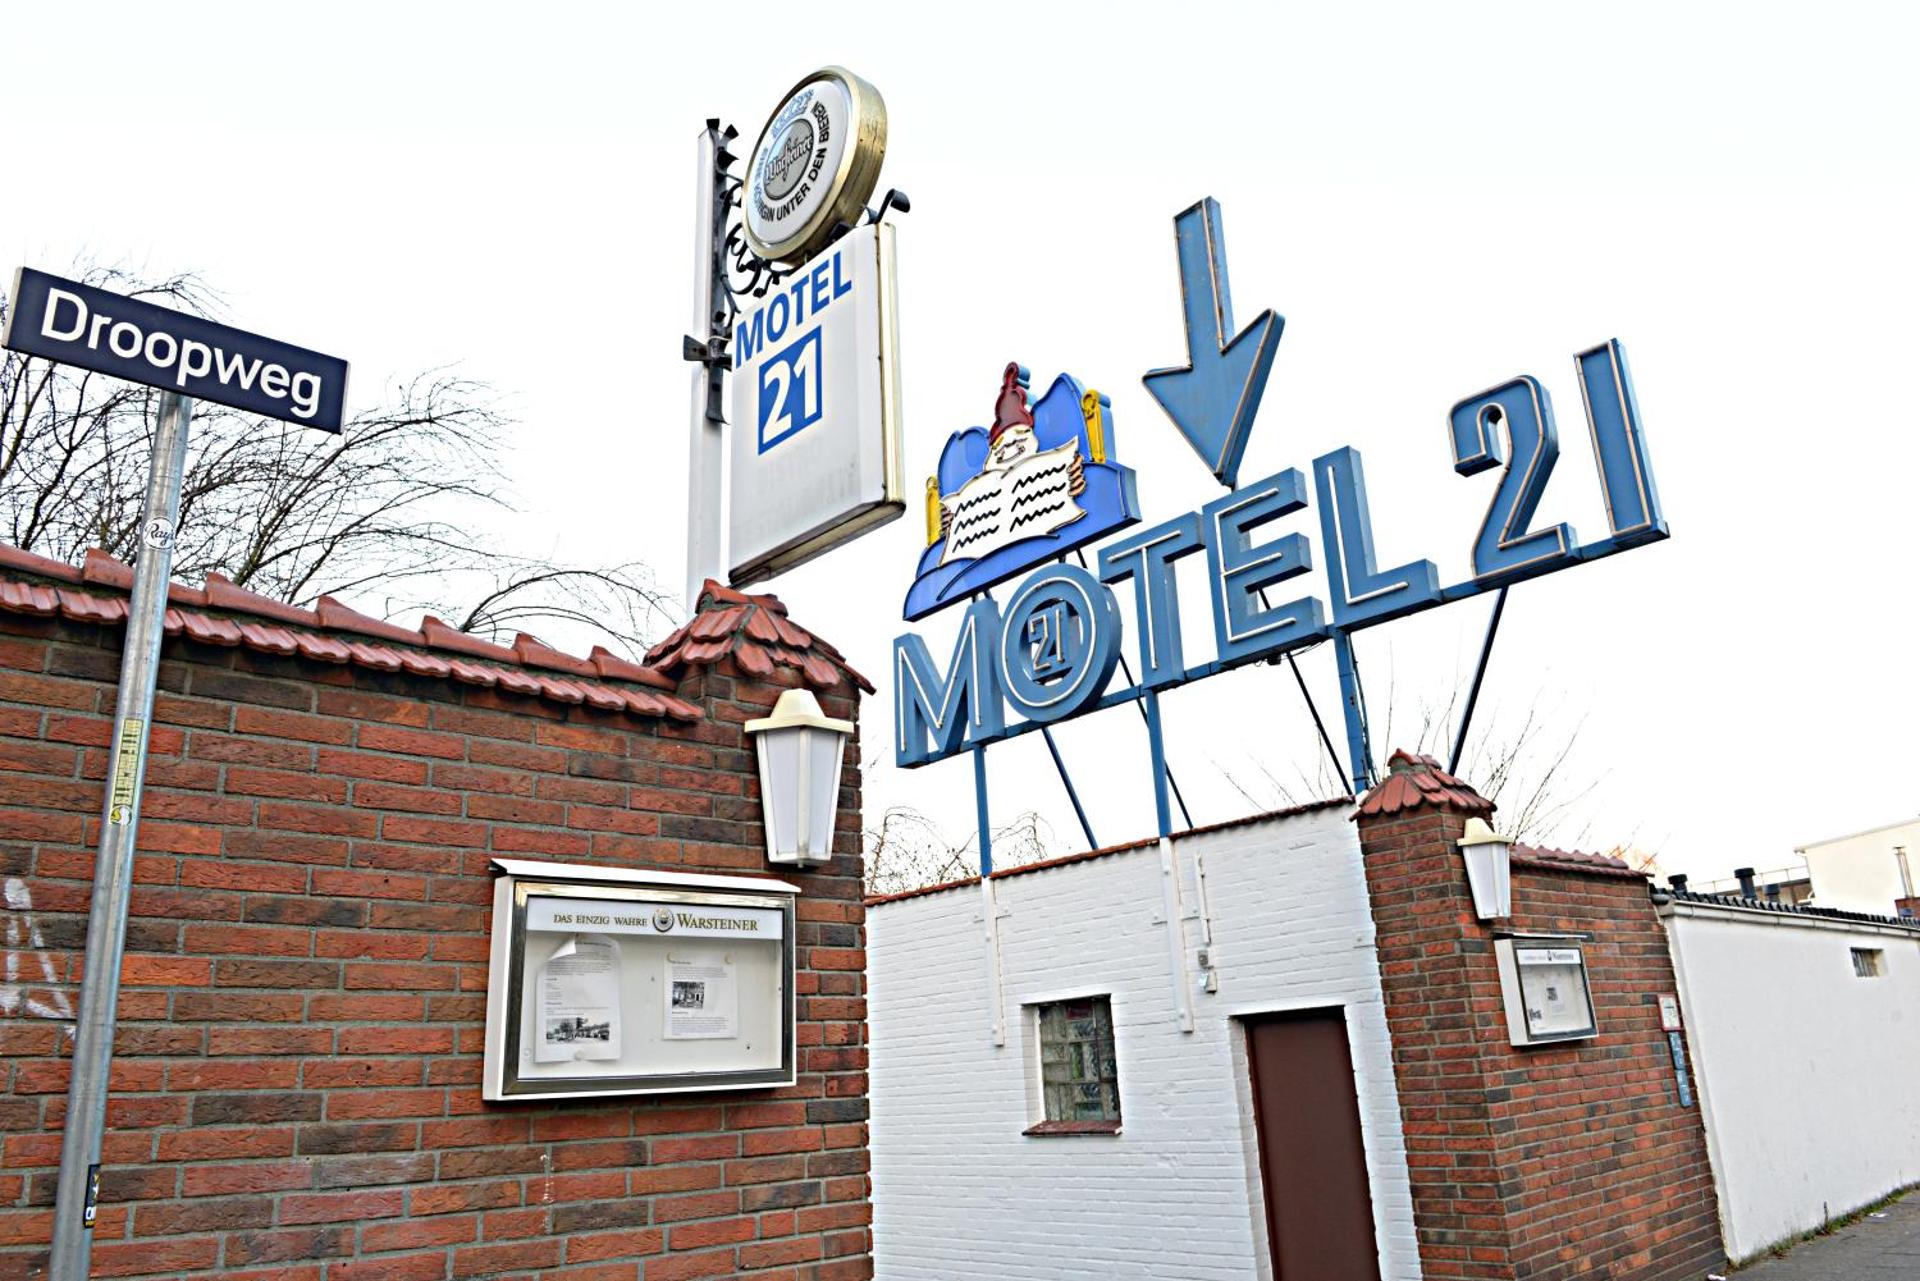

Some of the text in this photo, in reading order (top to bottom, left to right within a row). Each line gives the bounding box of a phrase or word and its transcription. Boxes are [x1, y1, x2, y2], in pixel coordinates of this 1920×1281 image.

[811, 101, 830, 144] BIEREN
[776, 183, 811, 221] UNTER
[808, 148, 828, 182] DEN
[735, 251, 852, 369] MOTEL
[40, 287, 322, 418] Droopweg
[762, 338, 818, 445] 21
[894, 338, 1670, 768] MOTEL 21
[1027, 600, 1070, 680] 21
[553, 913, 759, 932] DAS EINZIG WAHRE WARSTEINER
